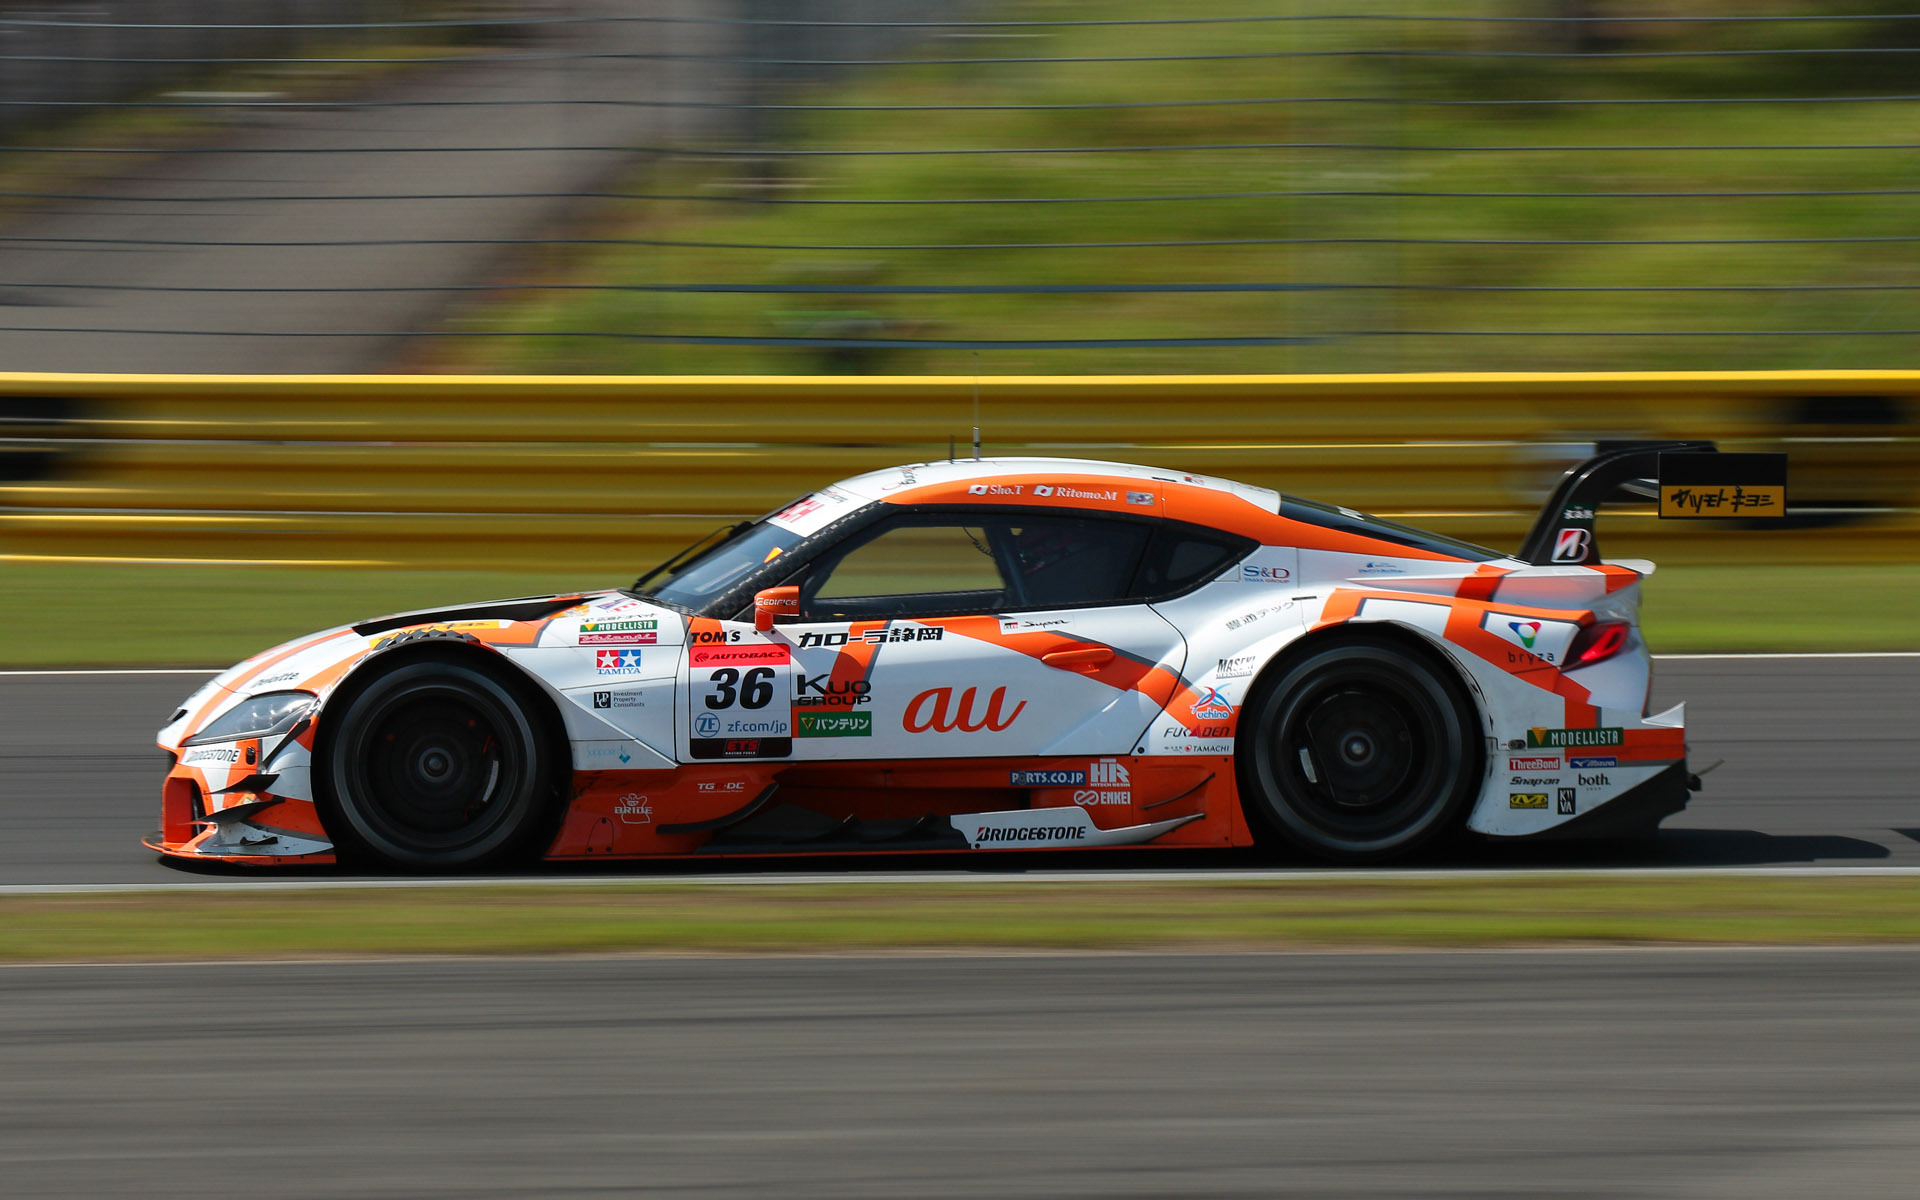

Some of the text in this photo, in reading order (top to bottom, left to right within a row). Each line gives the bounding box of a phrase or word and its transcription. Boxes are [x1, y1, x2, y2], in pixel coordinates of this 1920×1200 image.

[989, 484, 1024, 495] Sho.T
[1056, 486, 1118, 501] Ritomo.M
[1244, 565, 1290, 579] S&D
[598, 621, 654, 631] MODELLISTA
[691, 630, 740, 643] TOM'S
[799, 628, 943, 648] カローラ静岡
[710, 652, 785, 660] AUTOBACS
[1508, 651, 1555, 664] bryza
[597, 667, 641, 675] TAMIYA
[705, 667, 775, 710] 36
[797, 696, 871, 706] GROUP
[902, 686, 1028, 733] au
[1197, 708, 1229, 719] uchino
[727, 719, 788, 733] zf.com/jp
[816, 717, 870, 731] バンテリン
[1551, 730, 1618, 745] MODELLISTA
[727, 740, 759, 751] ETS
[1193, 745, 1229, 753] TAMACHI
[1511, 758, 1559, 769] ThreeBond
[1510, 776, 1560, 786] Snap-on
[1101, 791, 1131, 805] ENKEI
[614, 806, 653, 814] BRIDE
[976, 826, 1086, 841] BRIDGESTONE
